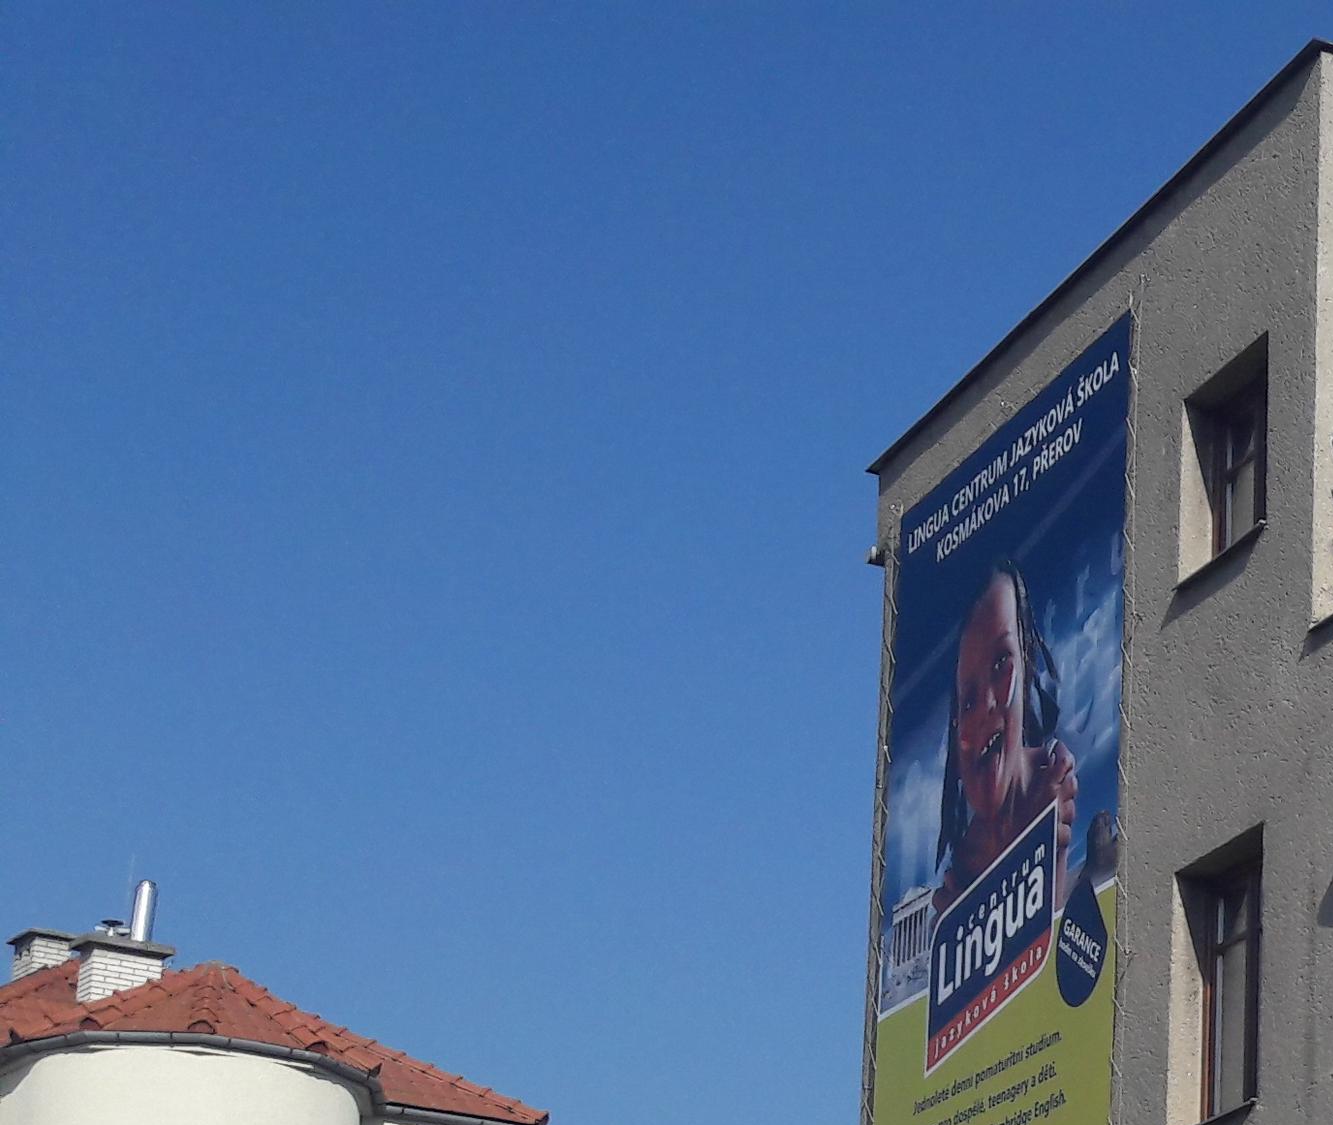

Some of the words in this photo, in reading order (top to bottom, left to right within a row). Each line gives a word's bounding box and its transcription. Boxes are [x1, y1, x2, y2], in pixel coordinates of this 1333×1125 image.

[908, 504, 949, 554] LINGUA
[951, 454, 1008, 517] CENTRUM
[1009, 386, 1074, 468] JAZYKOVÁ
[1077, 352, 1119, 406] ŠKOLA
[936, 487, 1010, 563] KOSMÁKOVA
[1013, 467, 1029, 497] 17,
[1033, 419, 1083, 481] PŘEROV
[937, 866, 1045, 1006] Lingua
[969, 844, 1045, 930] centrum
[1063, 918, 1101, 962] GARANCE
[934, 986, 997, 1059] jazyková
[1004, 946, 1042, 990] škola
